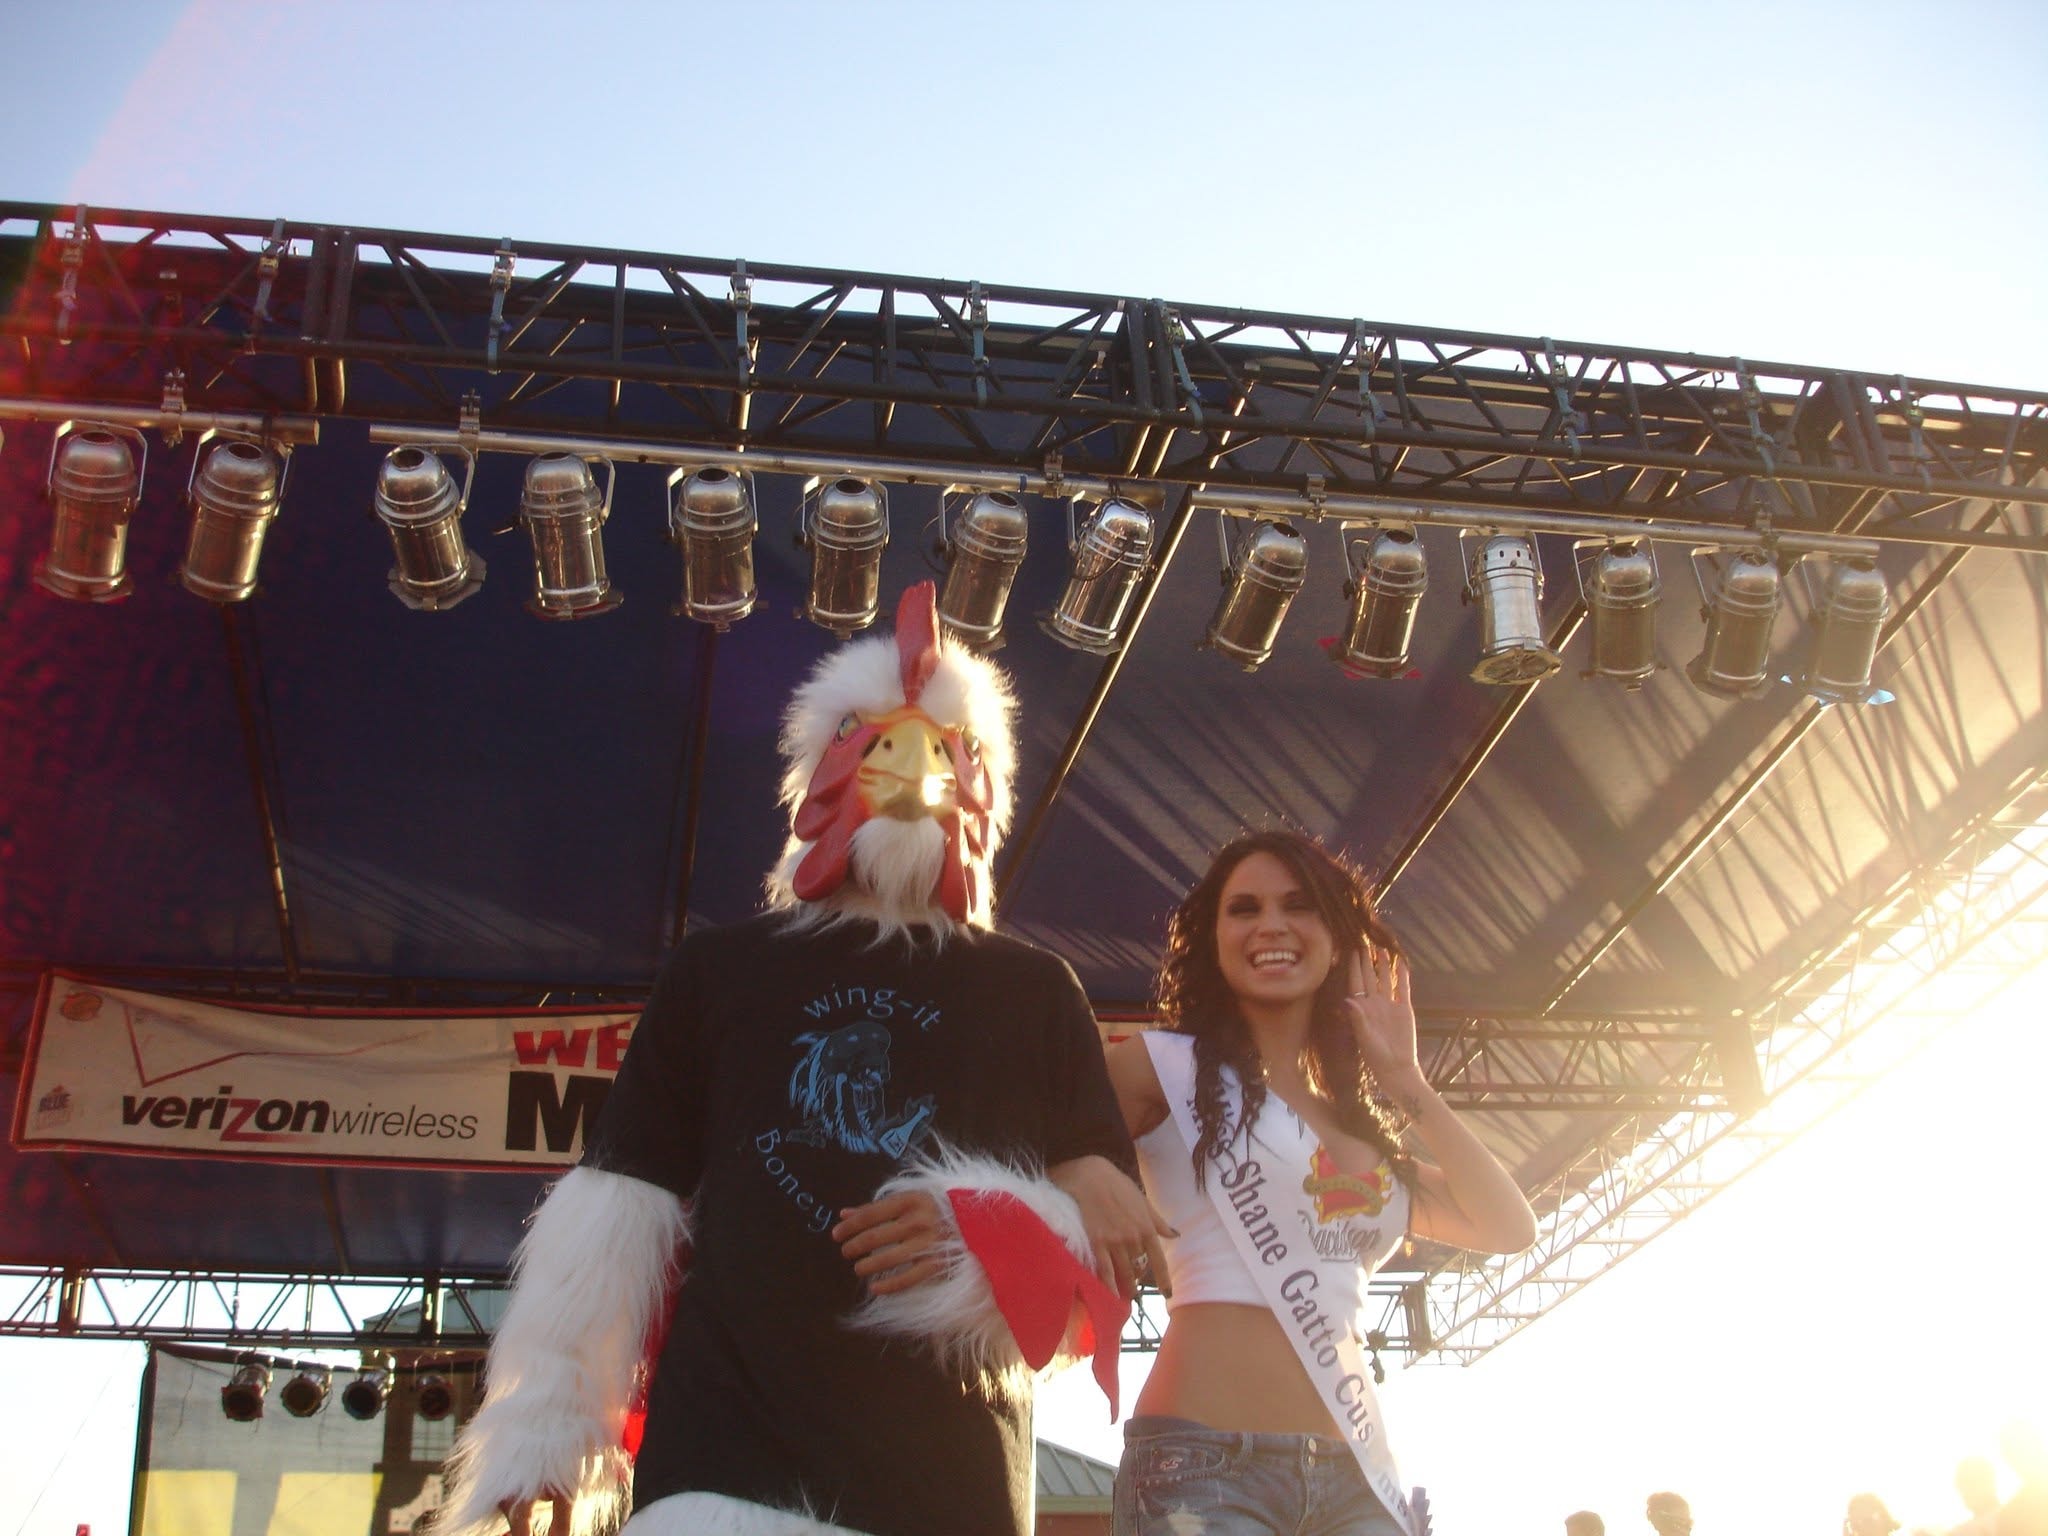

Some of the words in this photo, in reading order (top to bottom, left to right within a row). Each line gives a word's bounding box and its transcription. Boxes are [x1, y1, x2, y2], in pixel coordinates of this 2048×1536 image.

[122, 1085, 330, 1142] verizon
[331, 1102, 479, 1140] wireless
[756, 1128, 832, 1232] Boney
[1220, 1161, 1288, 1267] Shane
[1280, 1269, 1340, 1369] Gatto
